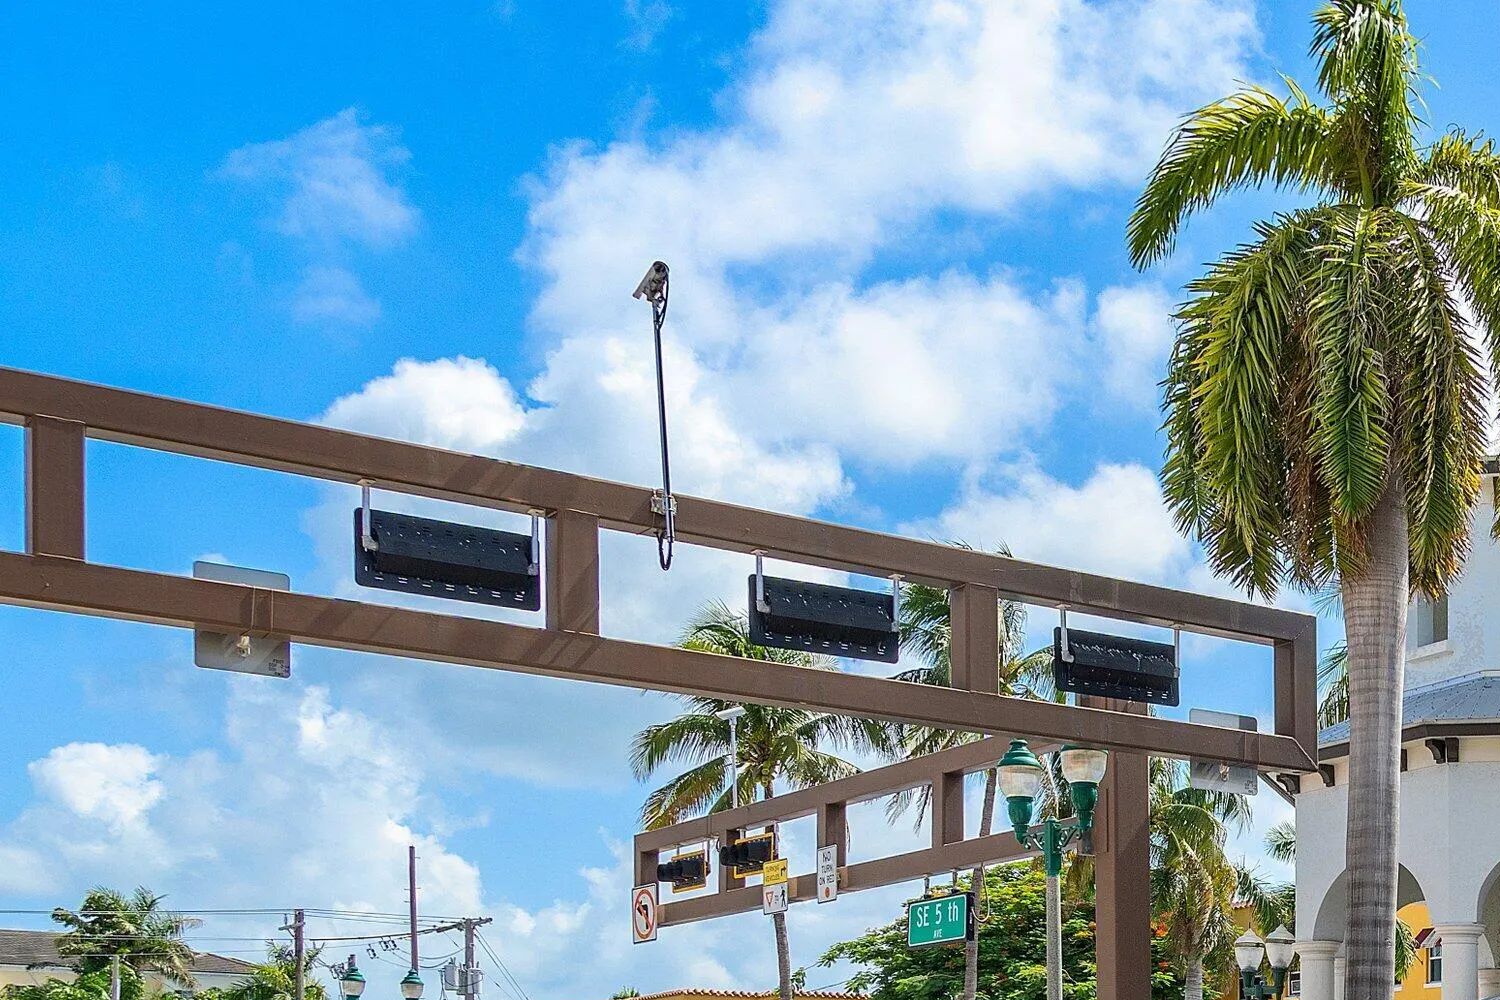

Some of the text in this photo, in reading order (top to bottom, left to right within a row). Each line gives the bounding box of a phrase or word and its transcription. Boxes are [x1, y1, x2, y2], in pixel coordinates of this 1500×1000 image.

[823, 851, 831, 863] NO
[821, 864, 833, 874] TURN
[916, 905, 930, 928] SE
[935, 903, 942, 925] 5
[948, 901, 959, 922] th
[933, 928, 943, 939] AVE
